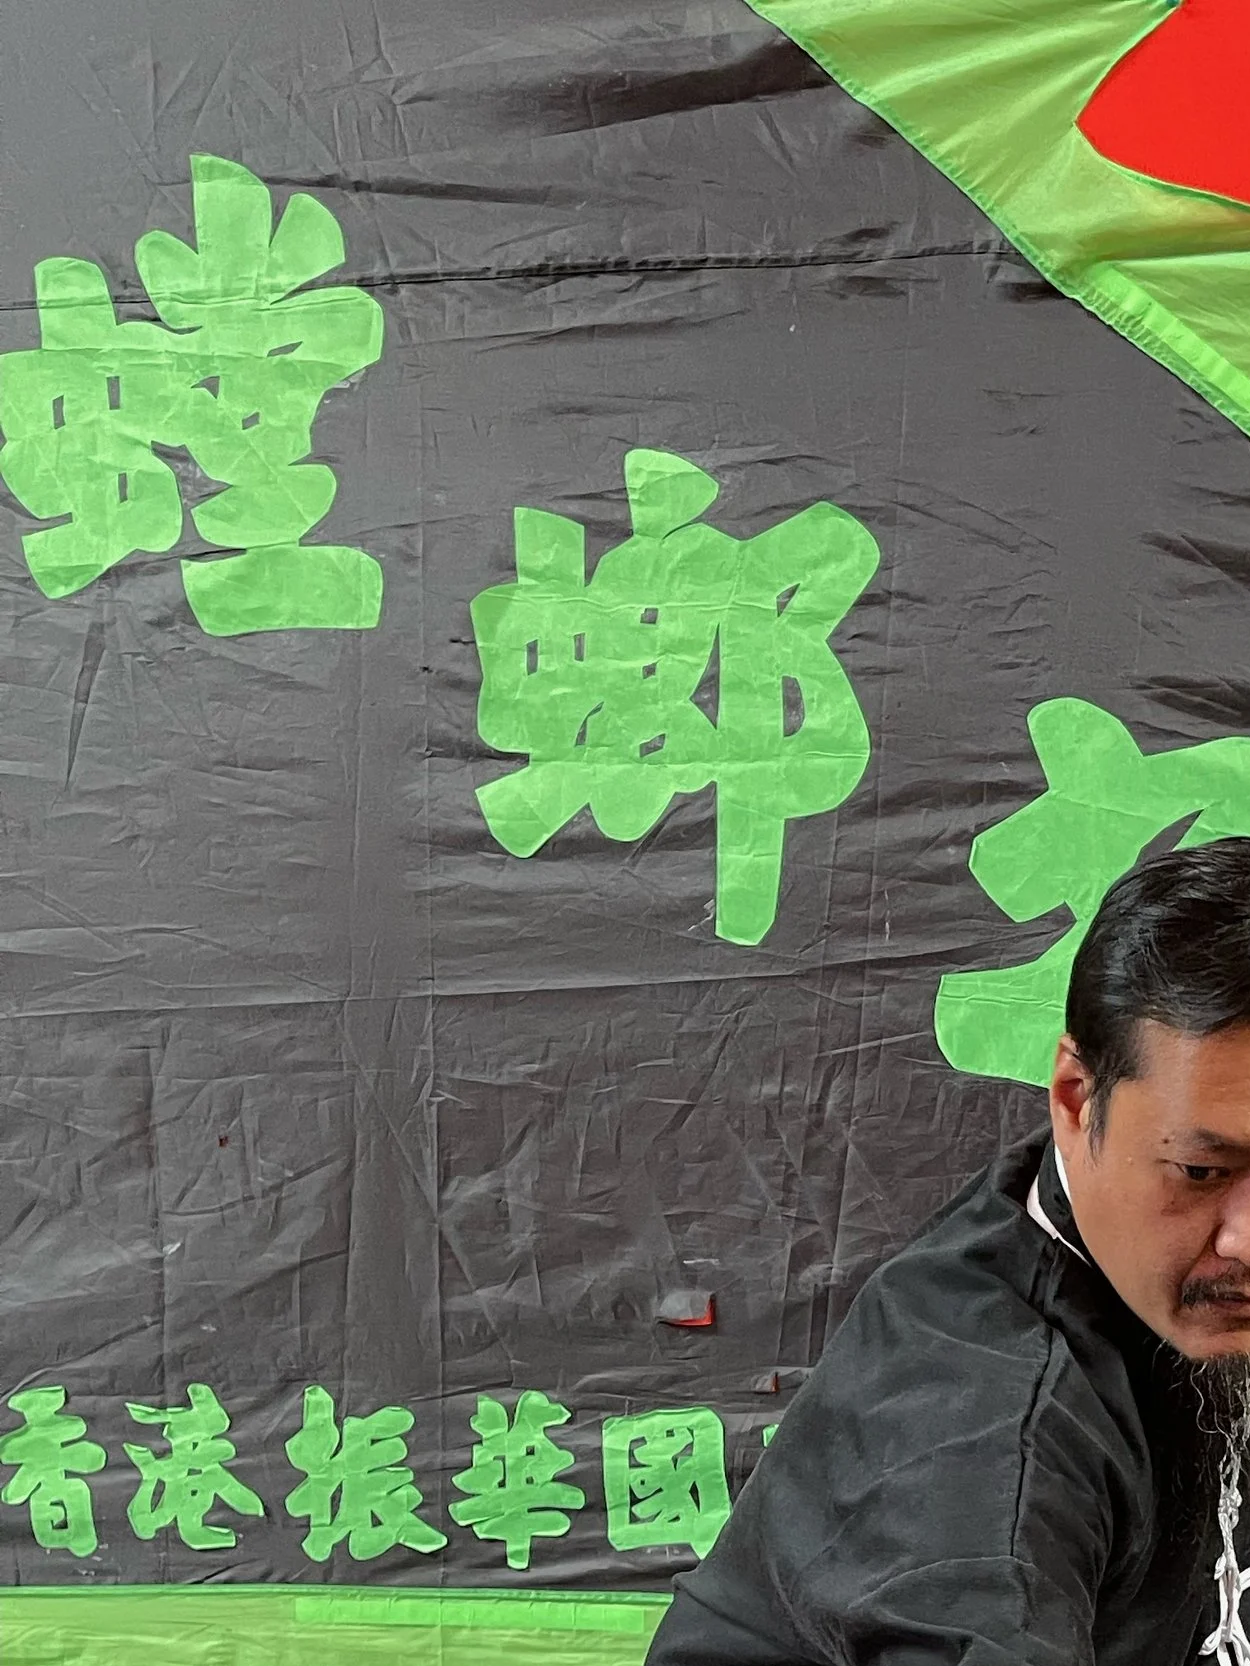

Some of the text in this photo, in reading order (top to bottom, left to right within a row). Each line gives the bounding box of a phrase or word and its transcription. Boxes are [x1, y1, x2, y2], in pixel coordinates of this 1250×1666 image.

[0, 1383, 779, 1570] 香港振華國
